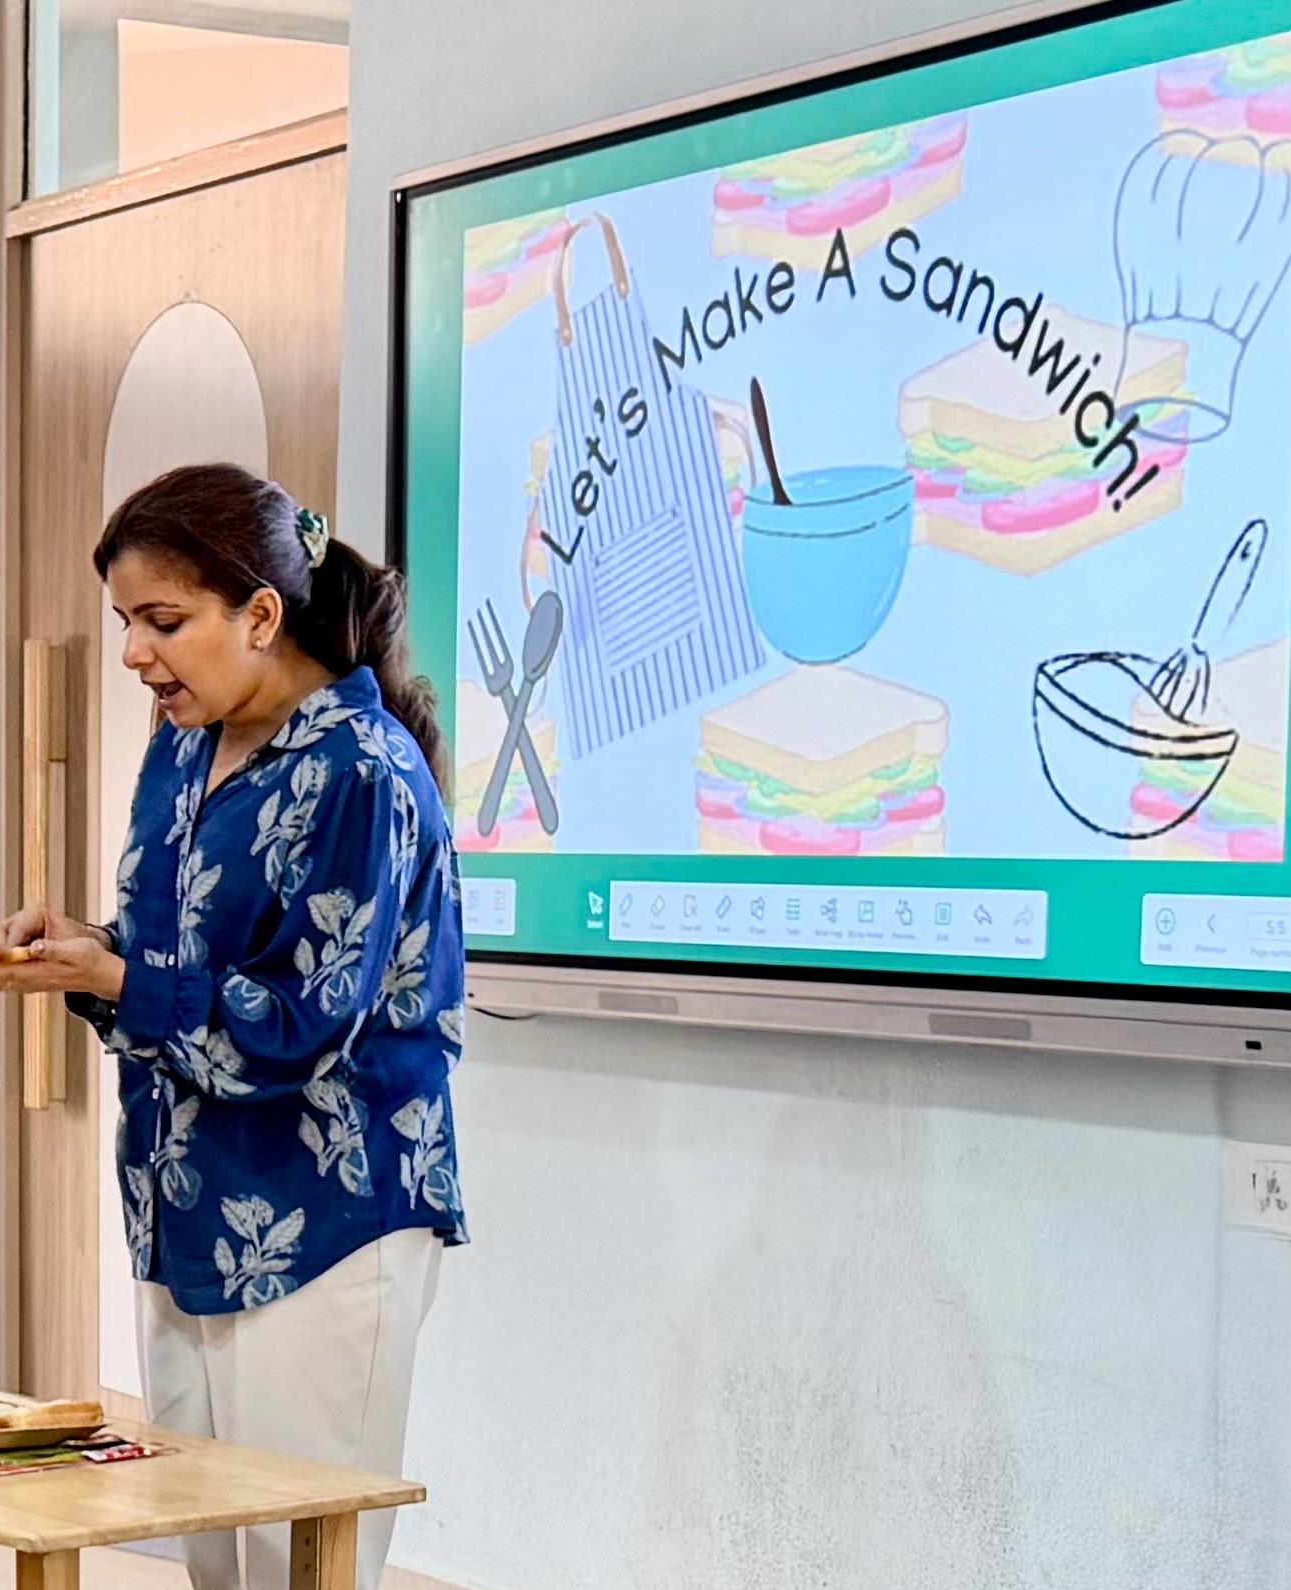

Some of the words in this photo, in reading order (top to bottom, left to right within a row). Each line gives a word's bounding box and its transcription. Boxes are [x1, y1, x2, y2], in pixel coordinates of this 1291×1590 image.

[539, 384, 649, 567] Let's
[652, 259, 796, 392] Make
[815, 227, 857, 302] A
[879, 227, 1162, 512] Sandwich!
